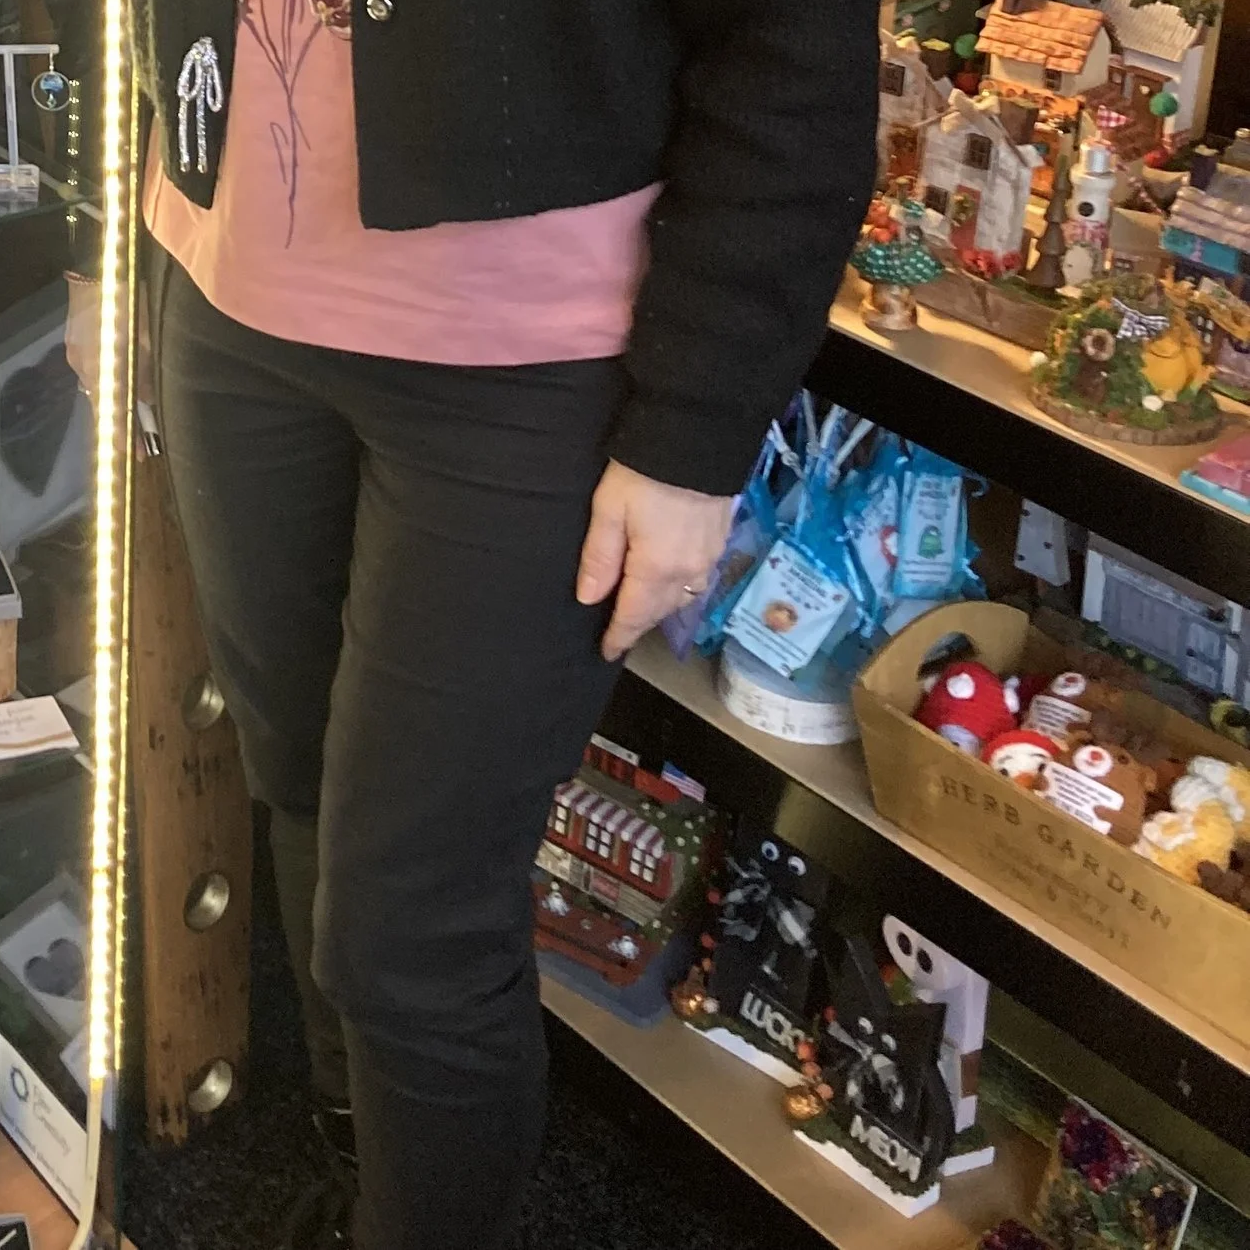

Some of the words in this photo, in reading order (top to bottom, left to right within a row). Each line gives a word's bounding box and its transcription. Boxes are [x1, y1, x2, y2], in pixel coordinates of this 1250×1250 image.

[942, 775, 1021, 826] HERB
[1037, 824, 1171, 930] GARDEN
[850, 1114, 921, 1183] MEOW
